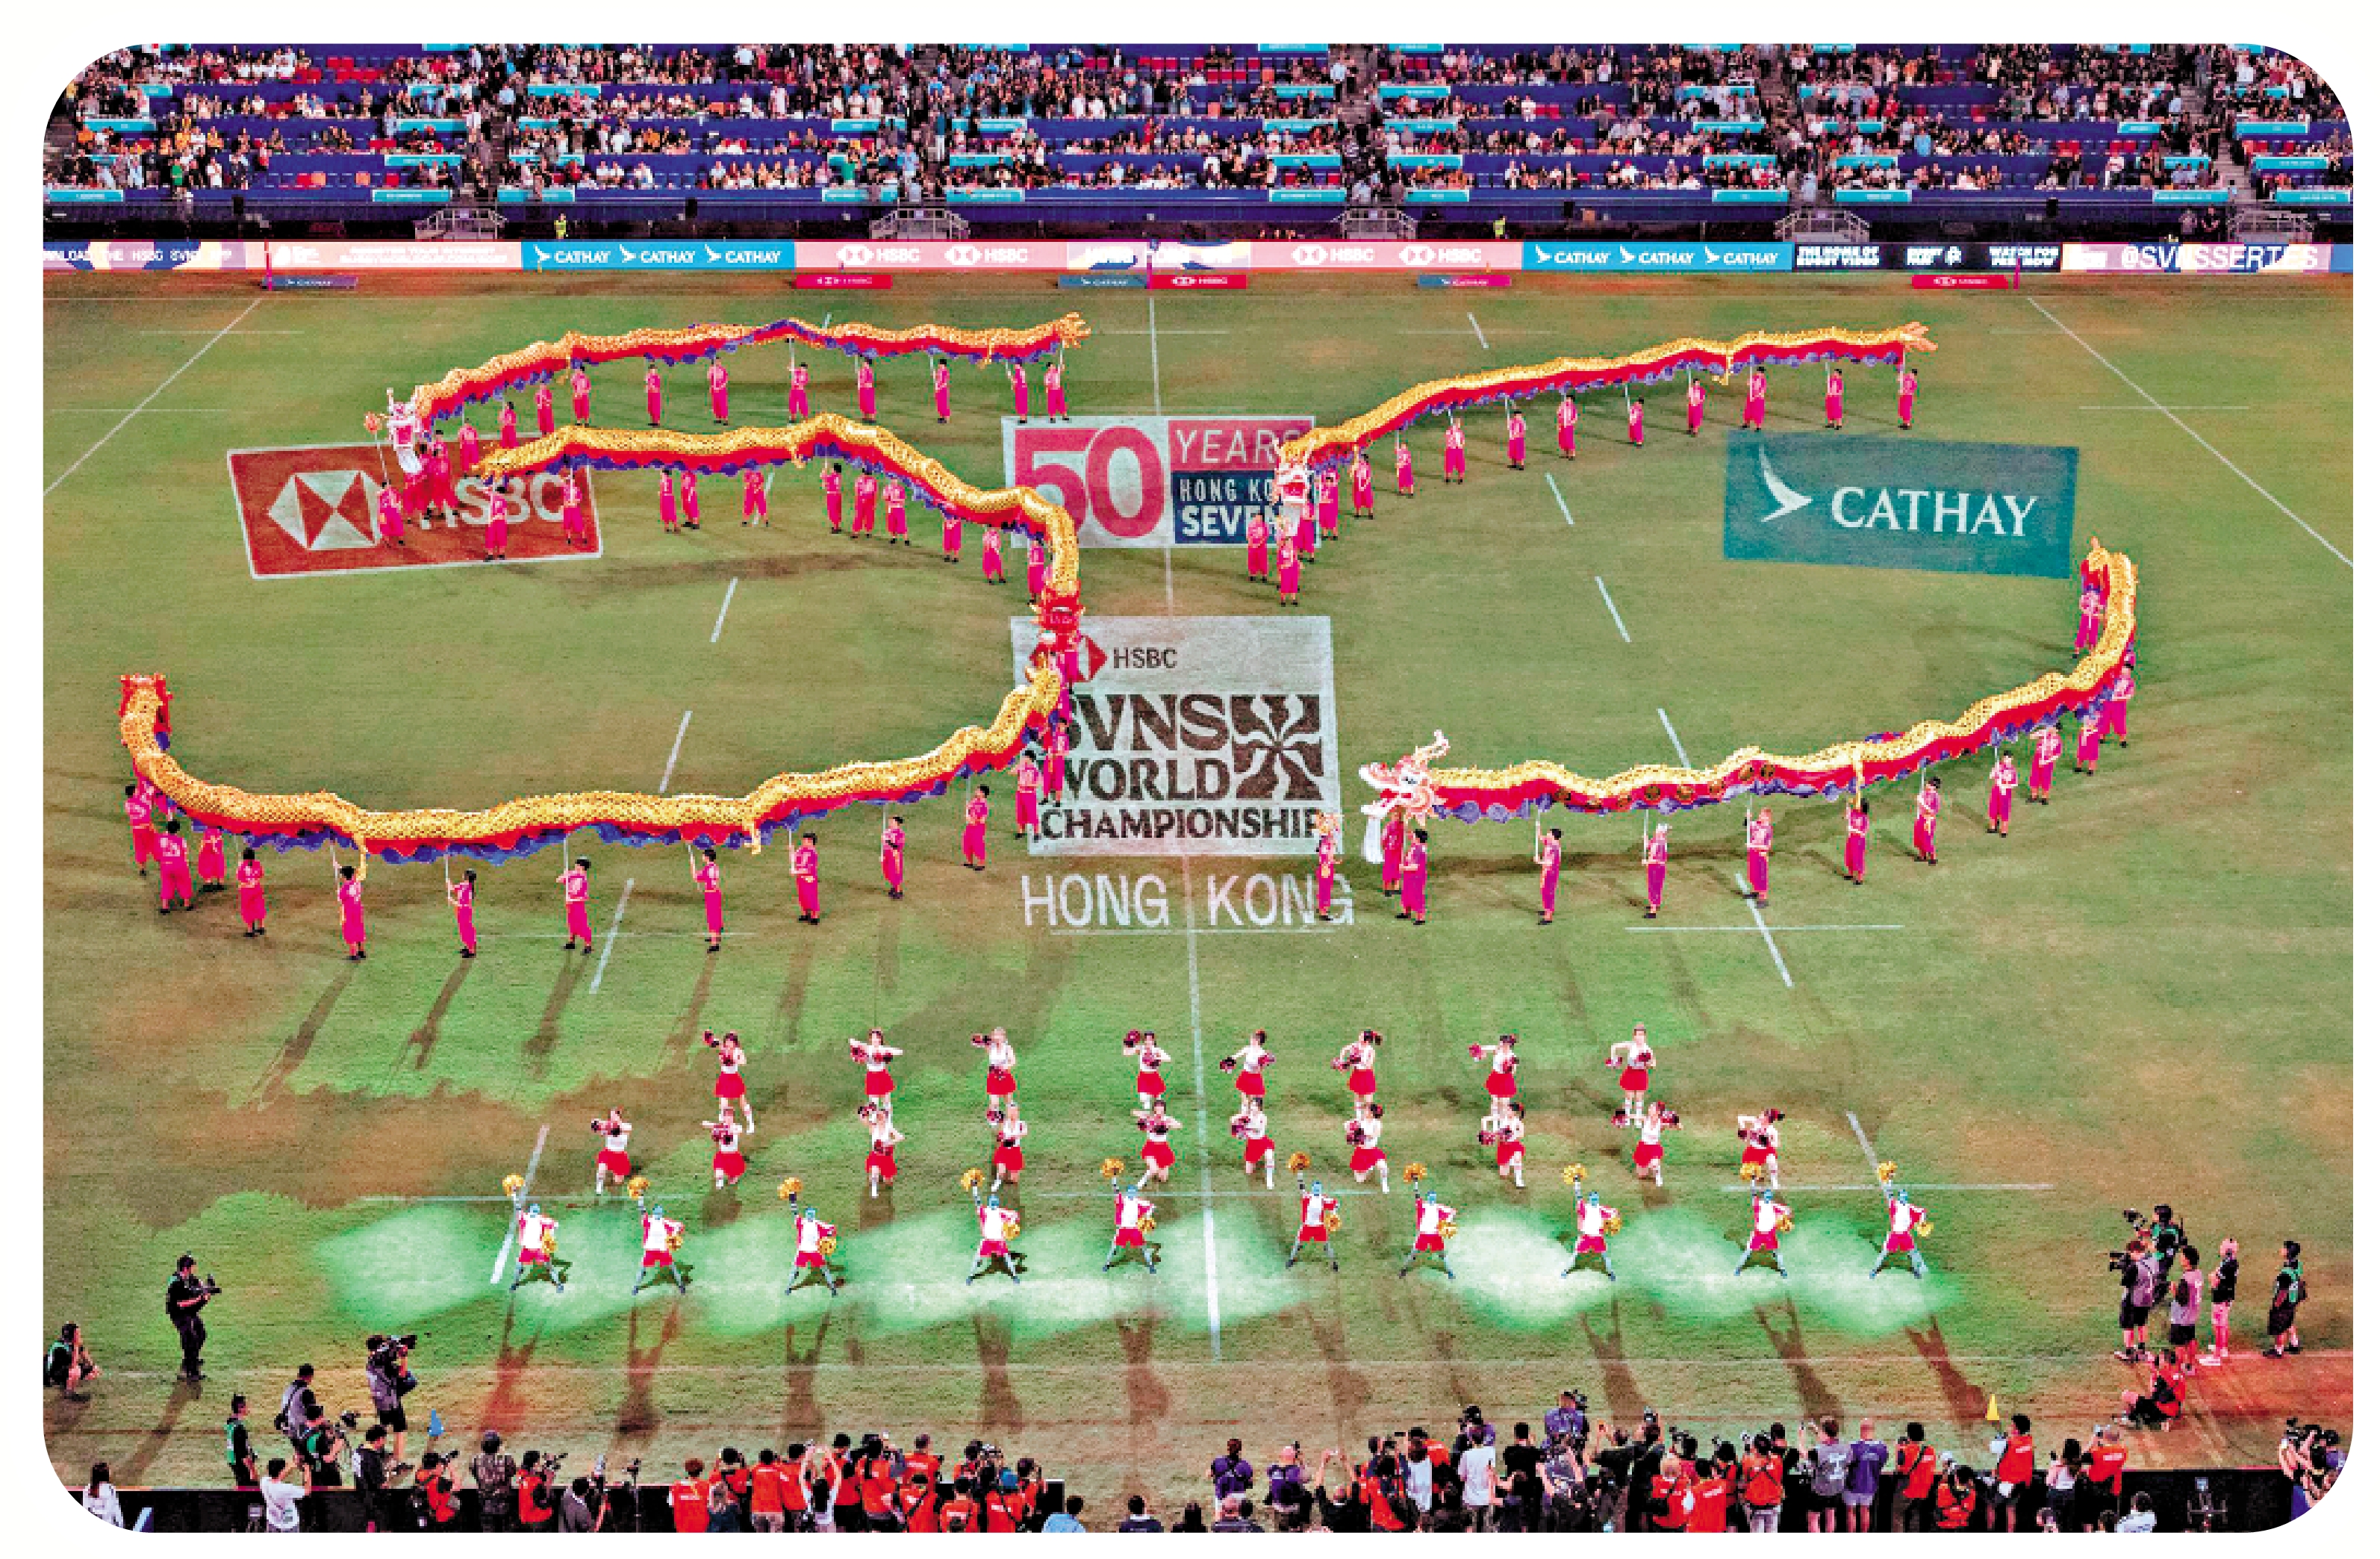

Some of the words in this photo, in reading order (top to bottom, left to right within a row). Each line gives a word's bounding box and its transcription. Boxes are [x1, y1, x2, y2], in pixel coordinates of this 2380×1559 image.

[555, 251, 611, 264] CATHAY
[641, 251, 696, 264] CATHAY
[725, 251, 782, 264] CATHAY
[876, 249, 920, 263] HSBC
[984, 249, 1029, 263] HSBC
[1330, 249, 1374, 263] HSBC
[1438, 249, 1482, 263] HSBC
[1554, 252, 1612, 265] CATHAY
[1638, 252, 1695, 265] CATHAY
[1723, 252, 1778, 265] CATHAY
[1015, 426, 1165, 539] 50
[1180, 479, 1236, 501] HONG
[420, 472, 565, 530] SBC
[1831, 486, 2039, 537] CATHAY
[1112, 648, 1178, 670] HSBC
[1021, 875, 1170, 927] HONG
[1207, 873, 1355, 927] KONG
